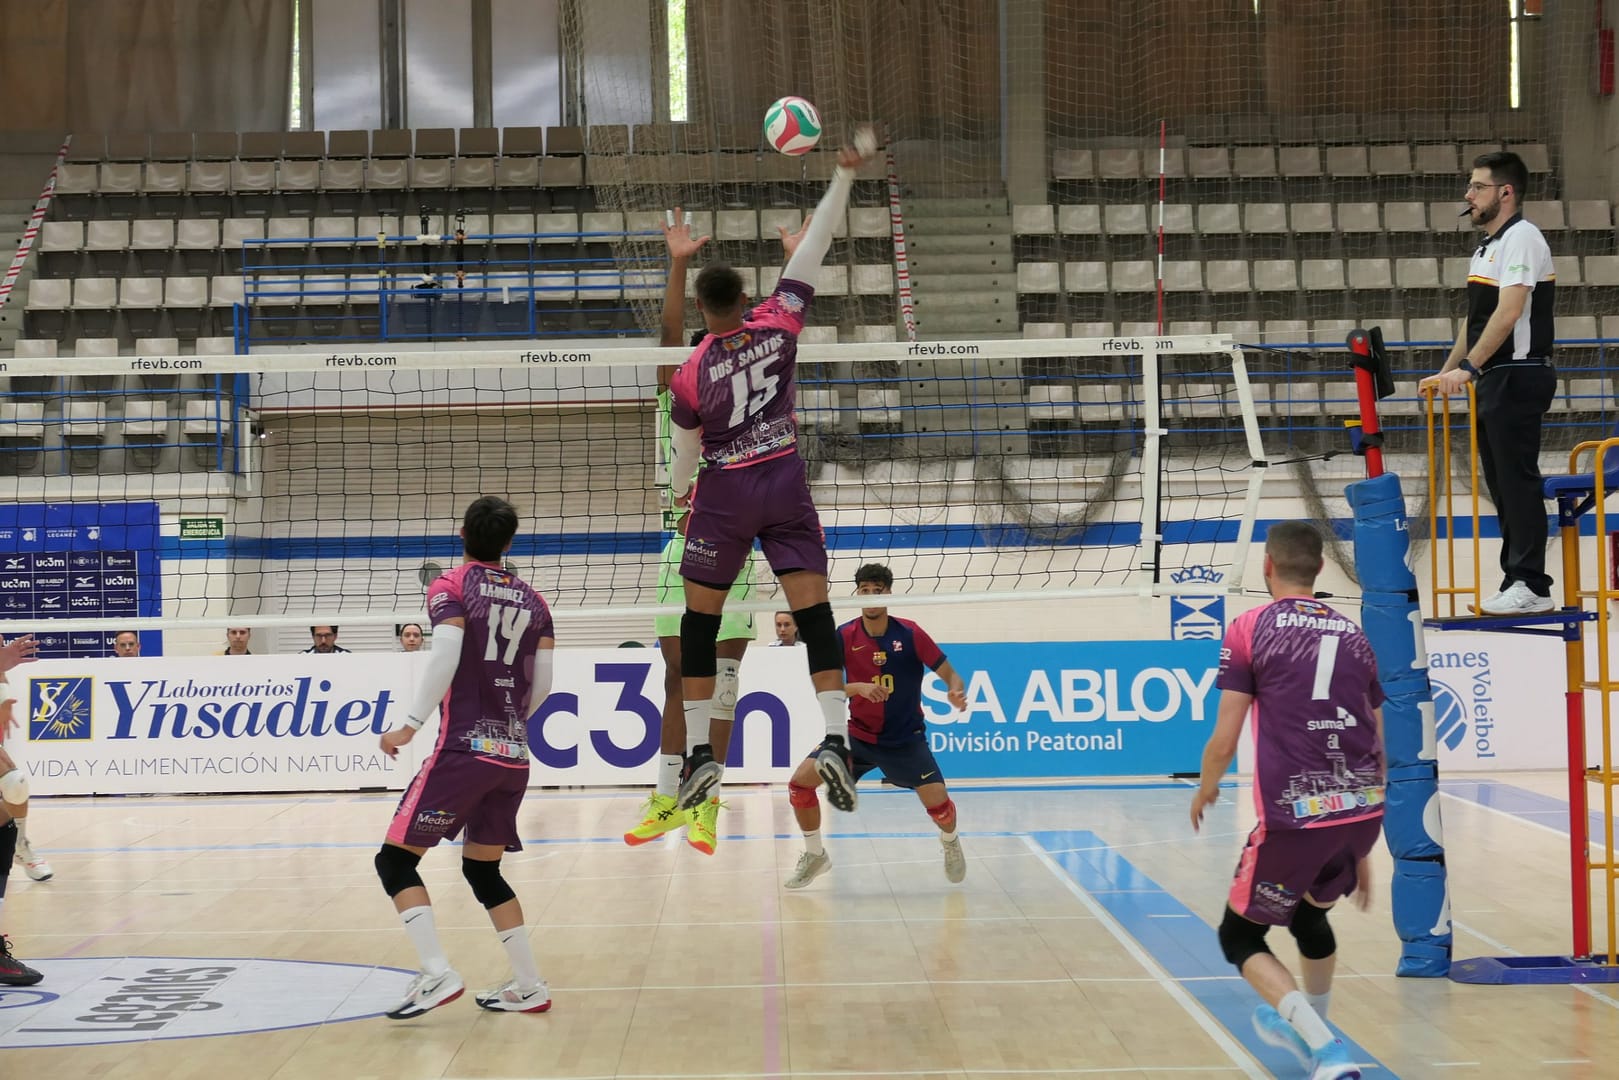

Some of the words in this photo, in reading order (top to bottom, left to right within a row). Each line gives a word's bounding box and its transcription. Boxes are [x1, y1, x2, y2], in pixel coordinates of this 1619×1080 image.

[520, 351, 591, 364] rfevb.com
[709, 358, 733, 383] DOS
[738, 333, 785, 367] SANTOS
[908, 343, 979, 356] rfevb.com
[131, 358, 202, 370] rfevb.com
[326, 354, 397, 367] rfevb.com
[728, 351, 780, 428] 15
[35, 557, 65, 567] uc3m
[1, 579, 31, 589] uc3m
[105, 576, 134, 586] uc3m
[484, 603, 532, 666] 14
[1311, 634, 1340, 700] 1
[157, 678, 294, 698] Laboratorios
[1016, 667, 1219, 723] ABLOY
[104, 676, 395, 740] Ynsadiet
[1472, 668, 1496, 759] Voleibol
[1307, 719, 1346, 731] suma
[931, 731, 1020, 753] División
[1026, 728, 1123, 752] Peatonal
[105, 752, 278, 775] ALIMENTACIÓN
[288, 754, 394, 773] NATURAL
[416, 812, 457, 825] Medsur
